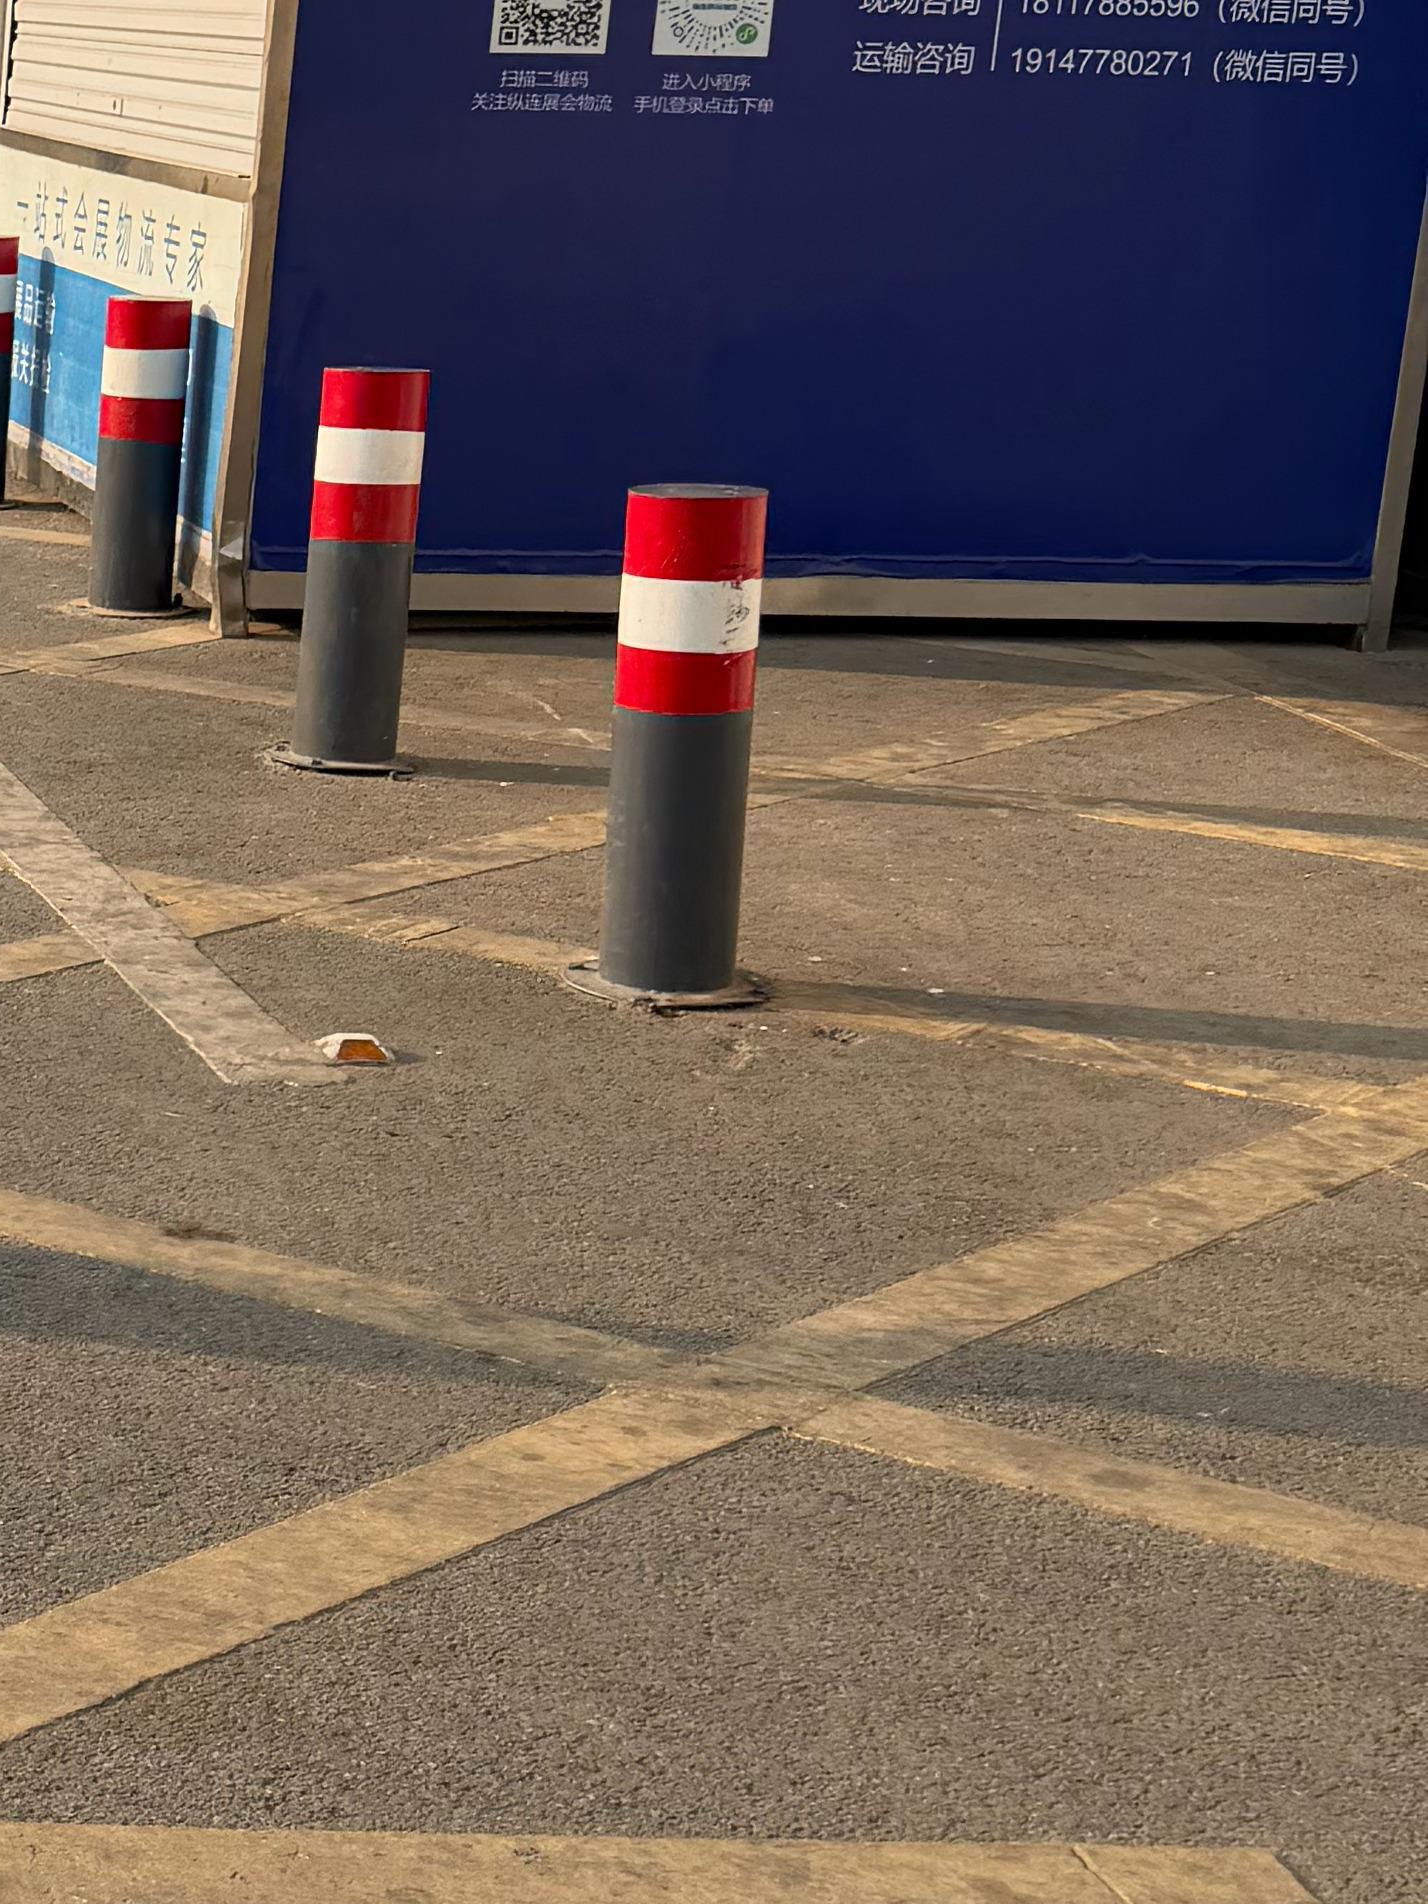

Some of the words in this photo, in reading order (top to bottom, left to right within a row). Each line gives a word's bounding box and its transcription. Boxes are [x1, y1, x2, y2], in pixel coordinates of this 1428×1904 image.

[851, 41, 976, 75] 运输咨询
[1011, 47, 1192, 77] 19147780271
[499, 69, 589, 89] 扫描二维码
[661, 73, 752, 92] 进入小程序
[471, 92, 613, 112] 关注纵连展会物流
[633, 95, 774, 115] 手机登录点击下单
[16, 181, 208, 293] 一站式会展物流专家
